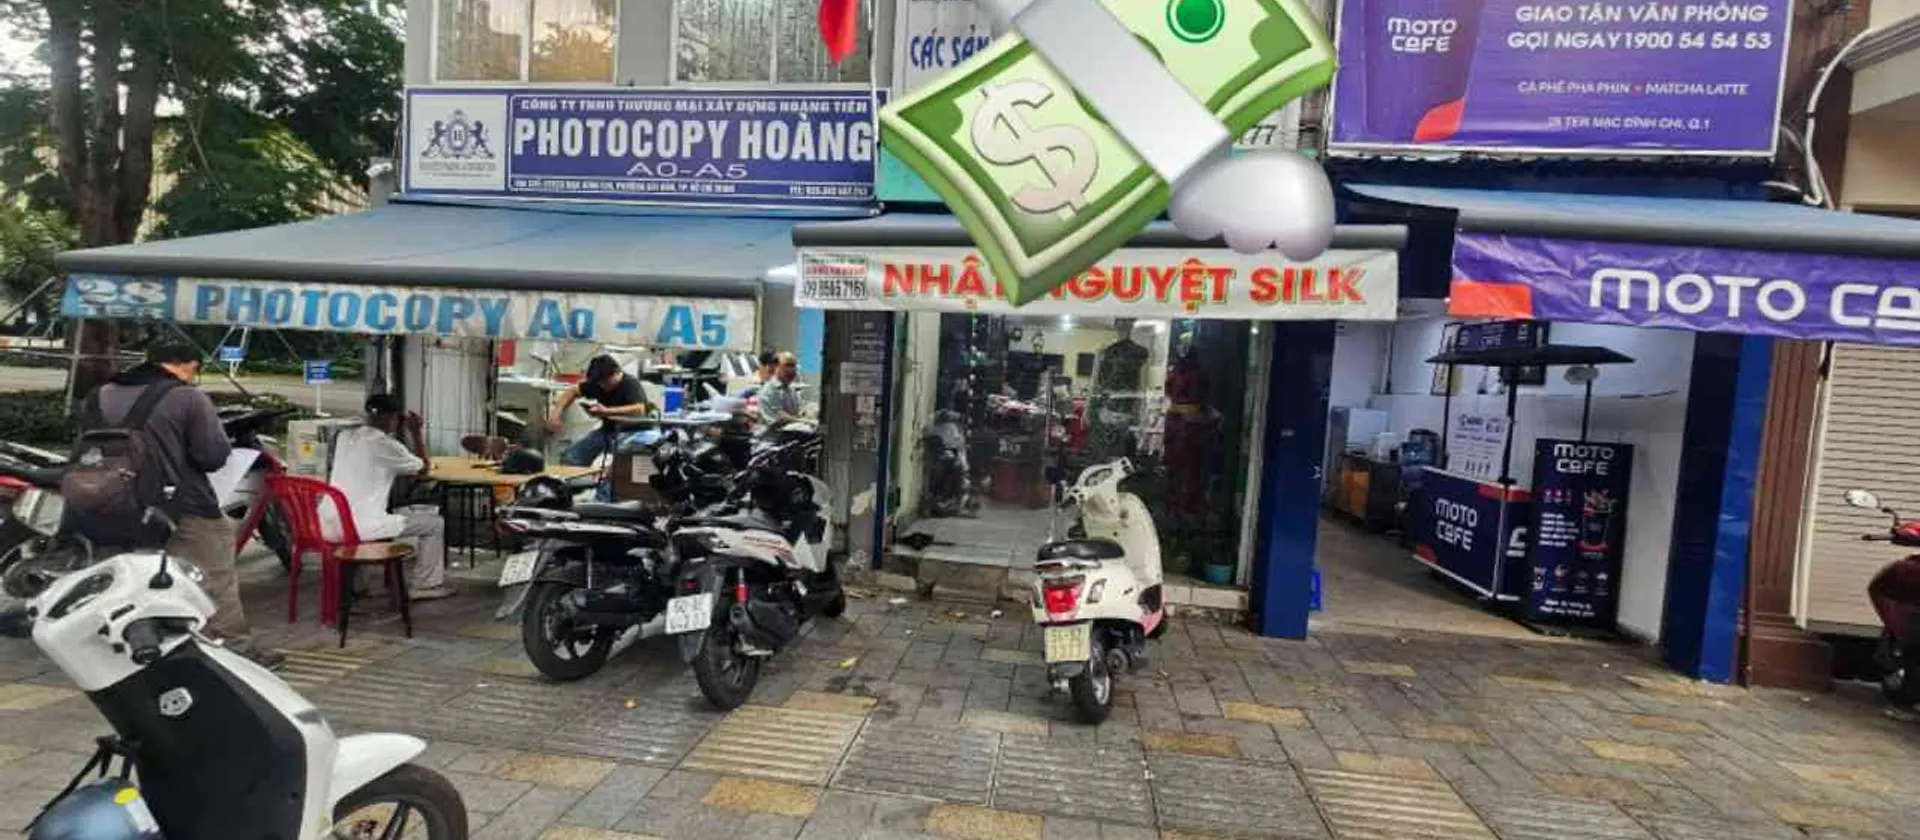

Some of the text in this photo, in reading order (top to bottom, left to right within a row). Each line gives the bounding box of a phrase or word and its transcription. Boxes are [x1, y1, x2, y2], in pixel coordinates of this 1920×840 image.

[1515, 2, 1769, 25] GIAO TẬN VĂN PHÒNG
[1387, 16, 1458, 36] MOTO
[910, 27, 946, 70] CÁC
[1507, 32, 1772, 51] GỌI NGAY 1900 54 54 53
[1706, 83, 1749, 96] LATTE
[560, 99, 576, 111] TY
[514, 112, 873, 162] PHOTOCOPY HOÀNG
[626, 161, 748, 180] A0-A5
[76, 279, 167, 304] 28
[882, 253, 1005, 309] NHẬ
[1249, 266, 1367, 304] SILK
[1589, 267, 1806, 322] MOTO
[195, 283, 511, 336] PHOTOCOPY
[657, 304, 727, 346] A5
[1553, 443, 1614, 459] MOTO
[1556, 458, 1609, 476] CAFE
[1435, 497, 1478, 528] MOTO
[1436, 520, 1474, 552] CAFE
